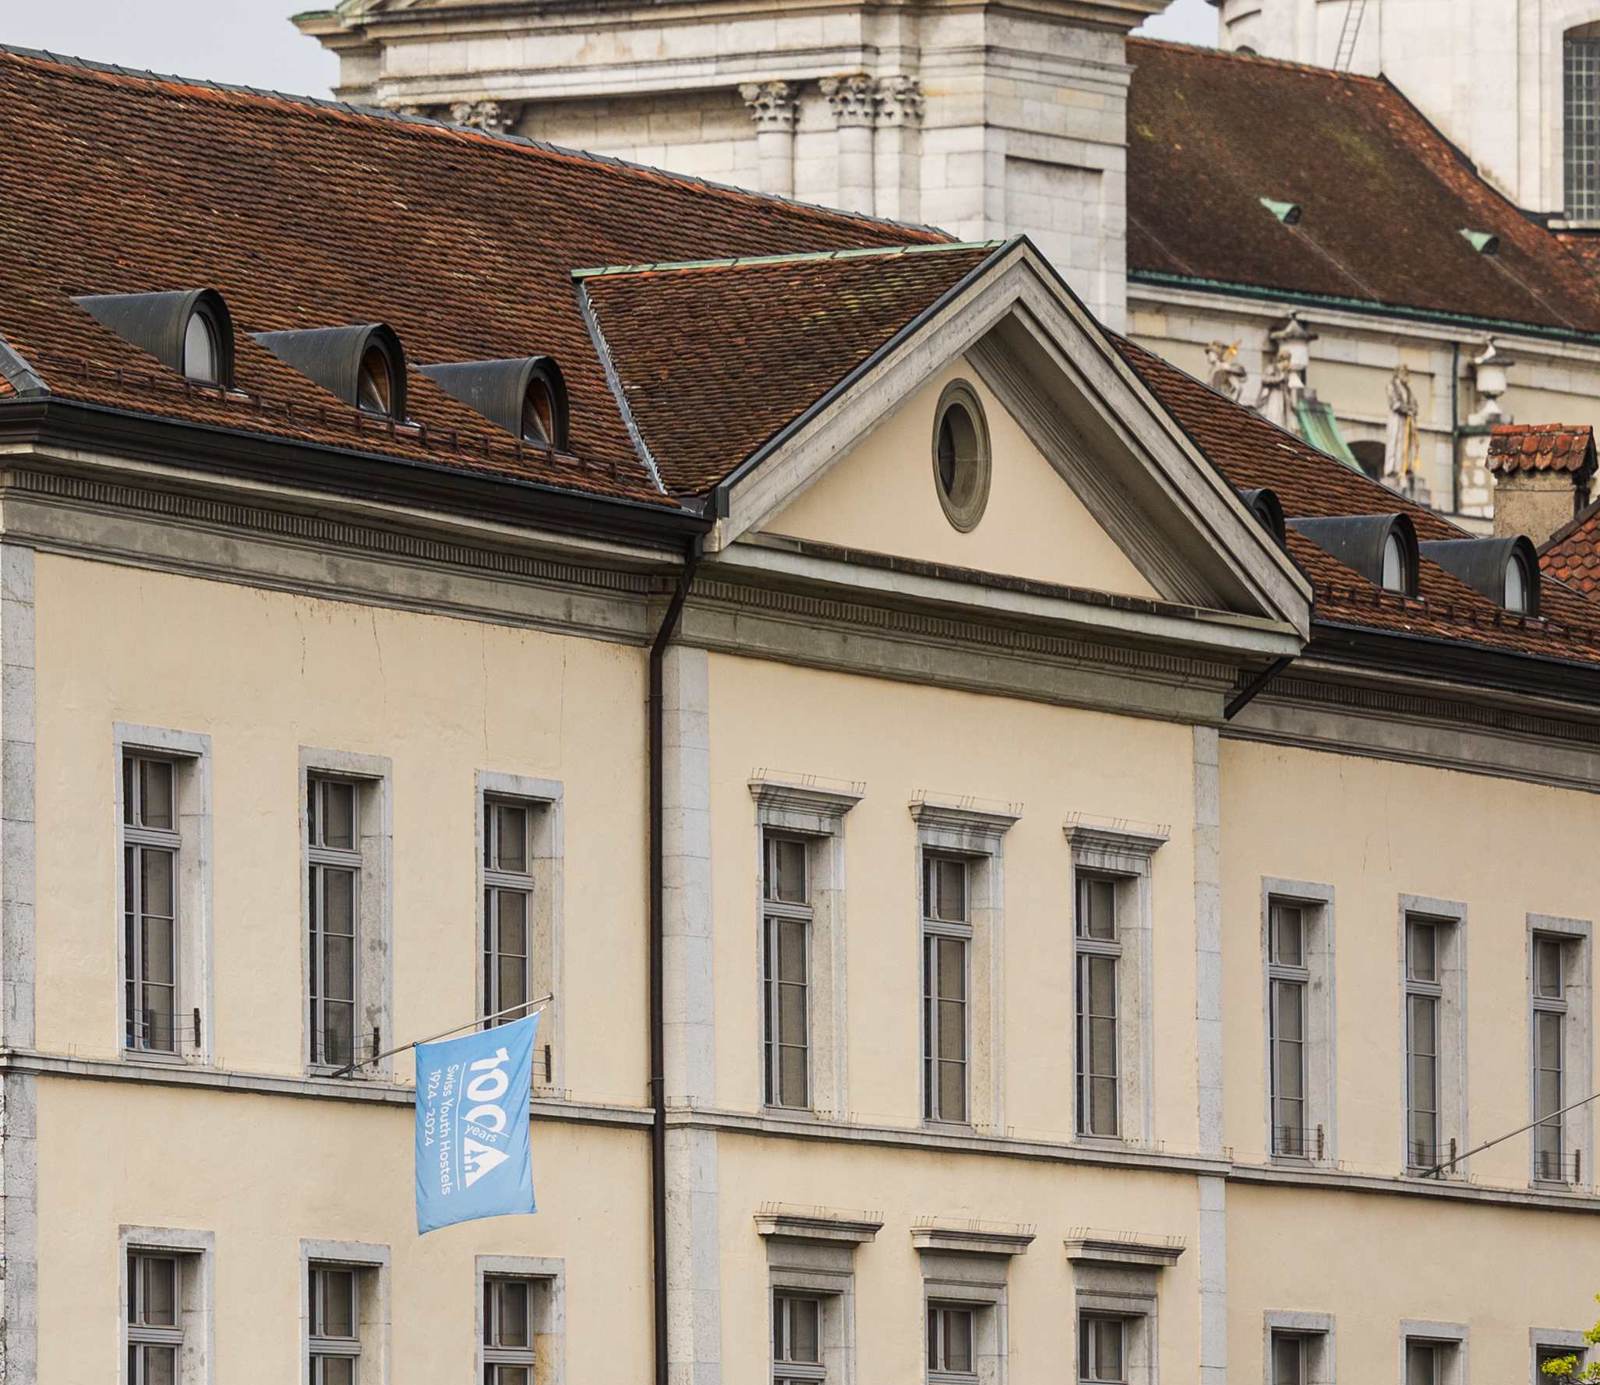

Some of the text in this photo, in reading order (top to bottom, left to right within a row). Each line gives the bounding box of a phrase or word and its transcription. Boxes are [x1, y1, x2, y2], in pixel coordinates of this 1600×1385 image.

[440, 1064, 460, 1196] Swiss Youth Hostels
[465, 1047, 510, 1134] 100
[465, 1123, 497, 1142] years
